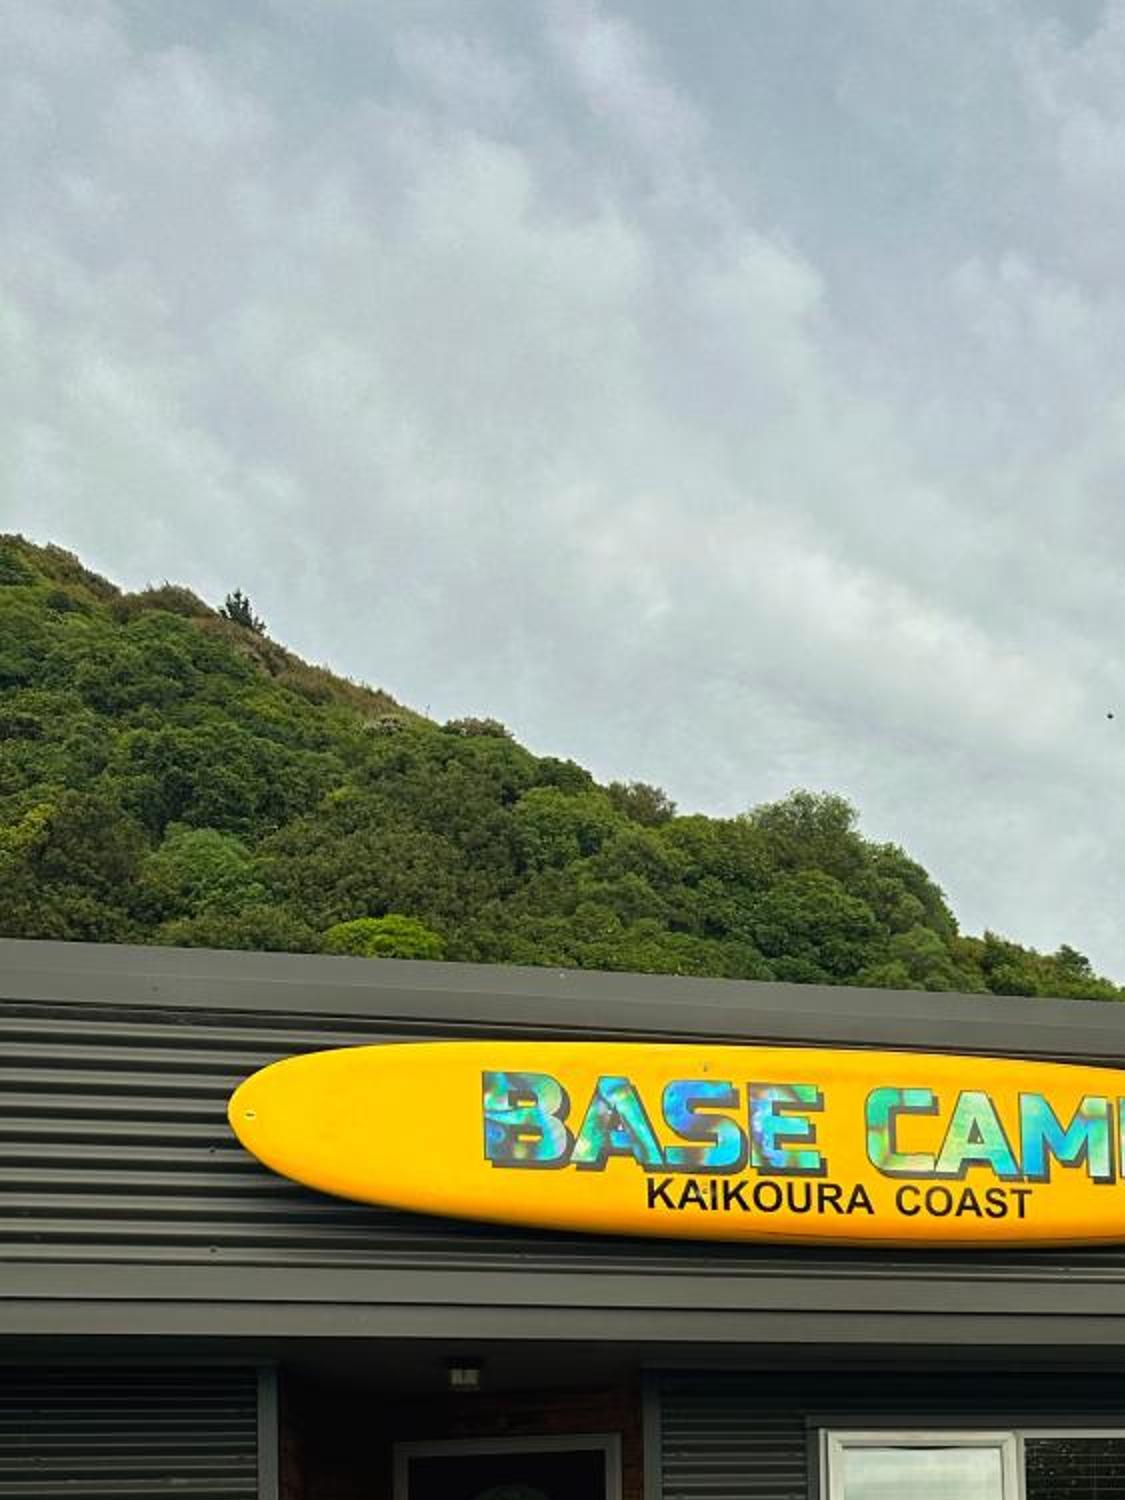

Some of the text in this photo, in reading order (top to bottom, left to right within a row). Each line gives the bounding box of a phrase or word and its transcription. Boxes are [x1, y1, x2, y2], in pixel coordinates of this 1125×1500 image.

[482, 1071, 828, 1178] BASE
[646, 1177, 1033, 1218] KAIKOURA COAST
